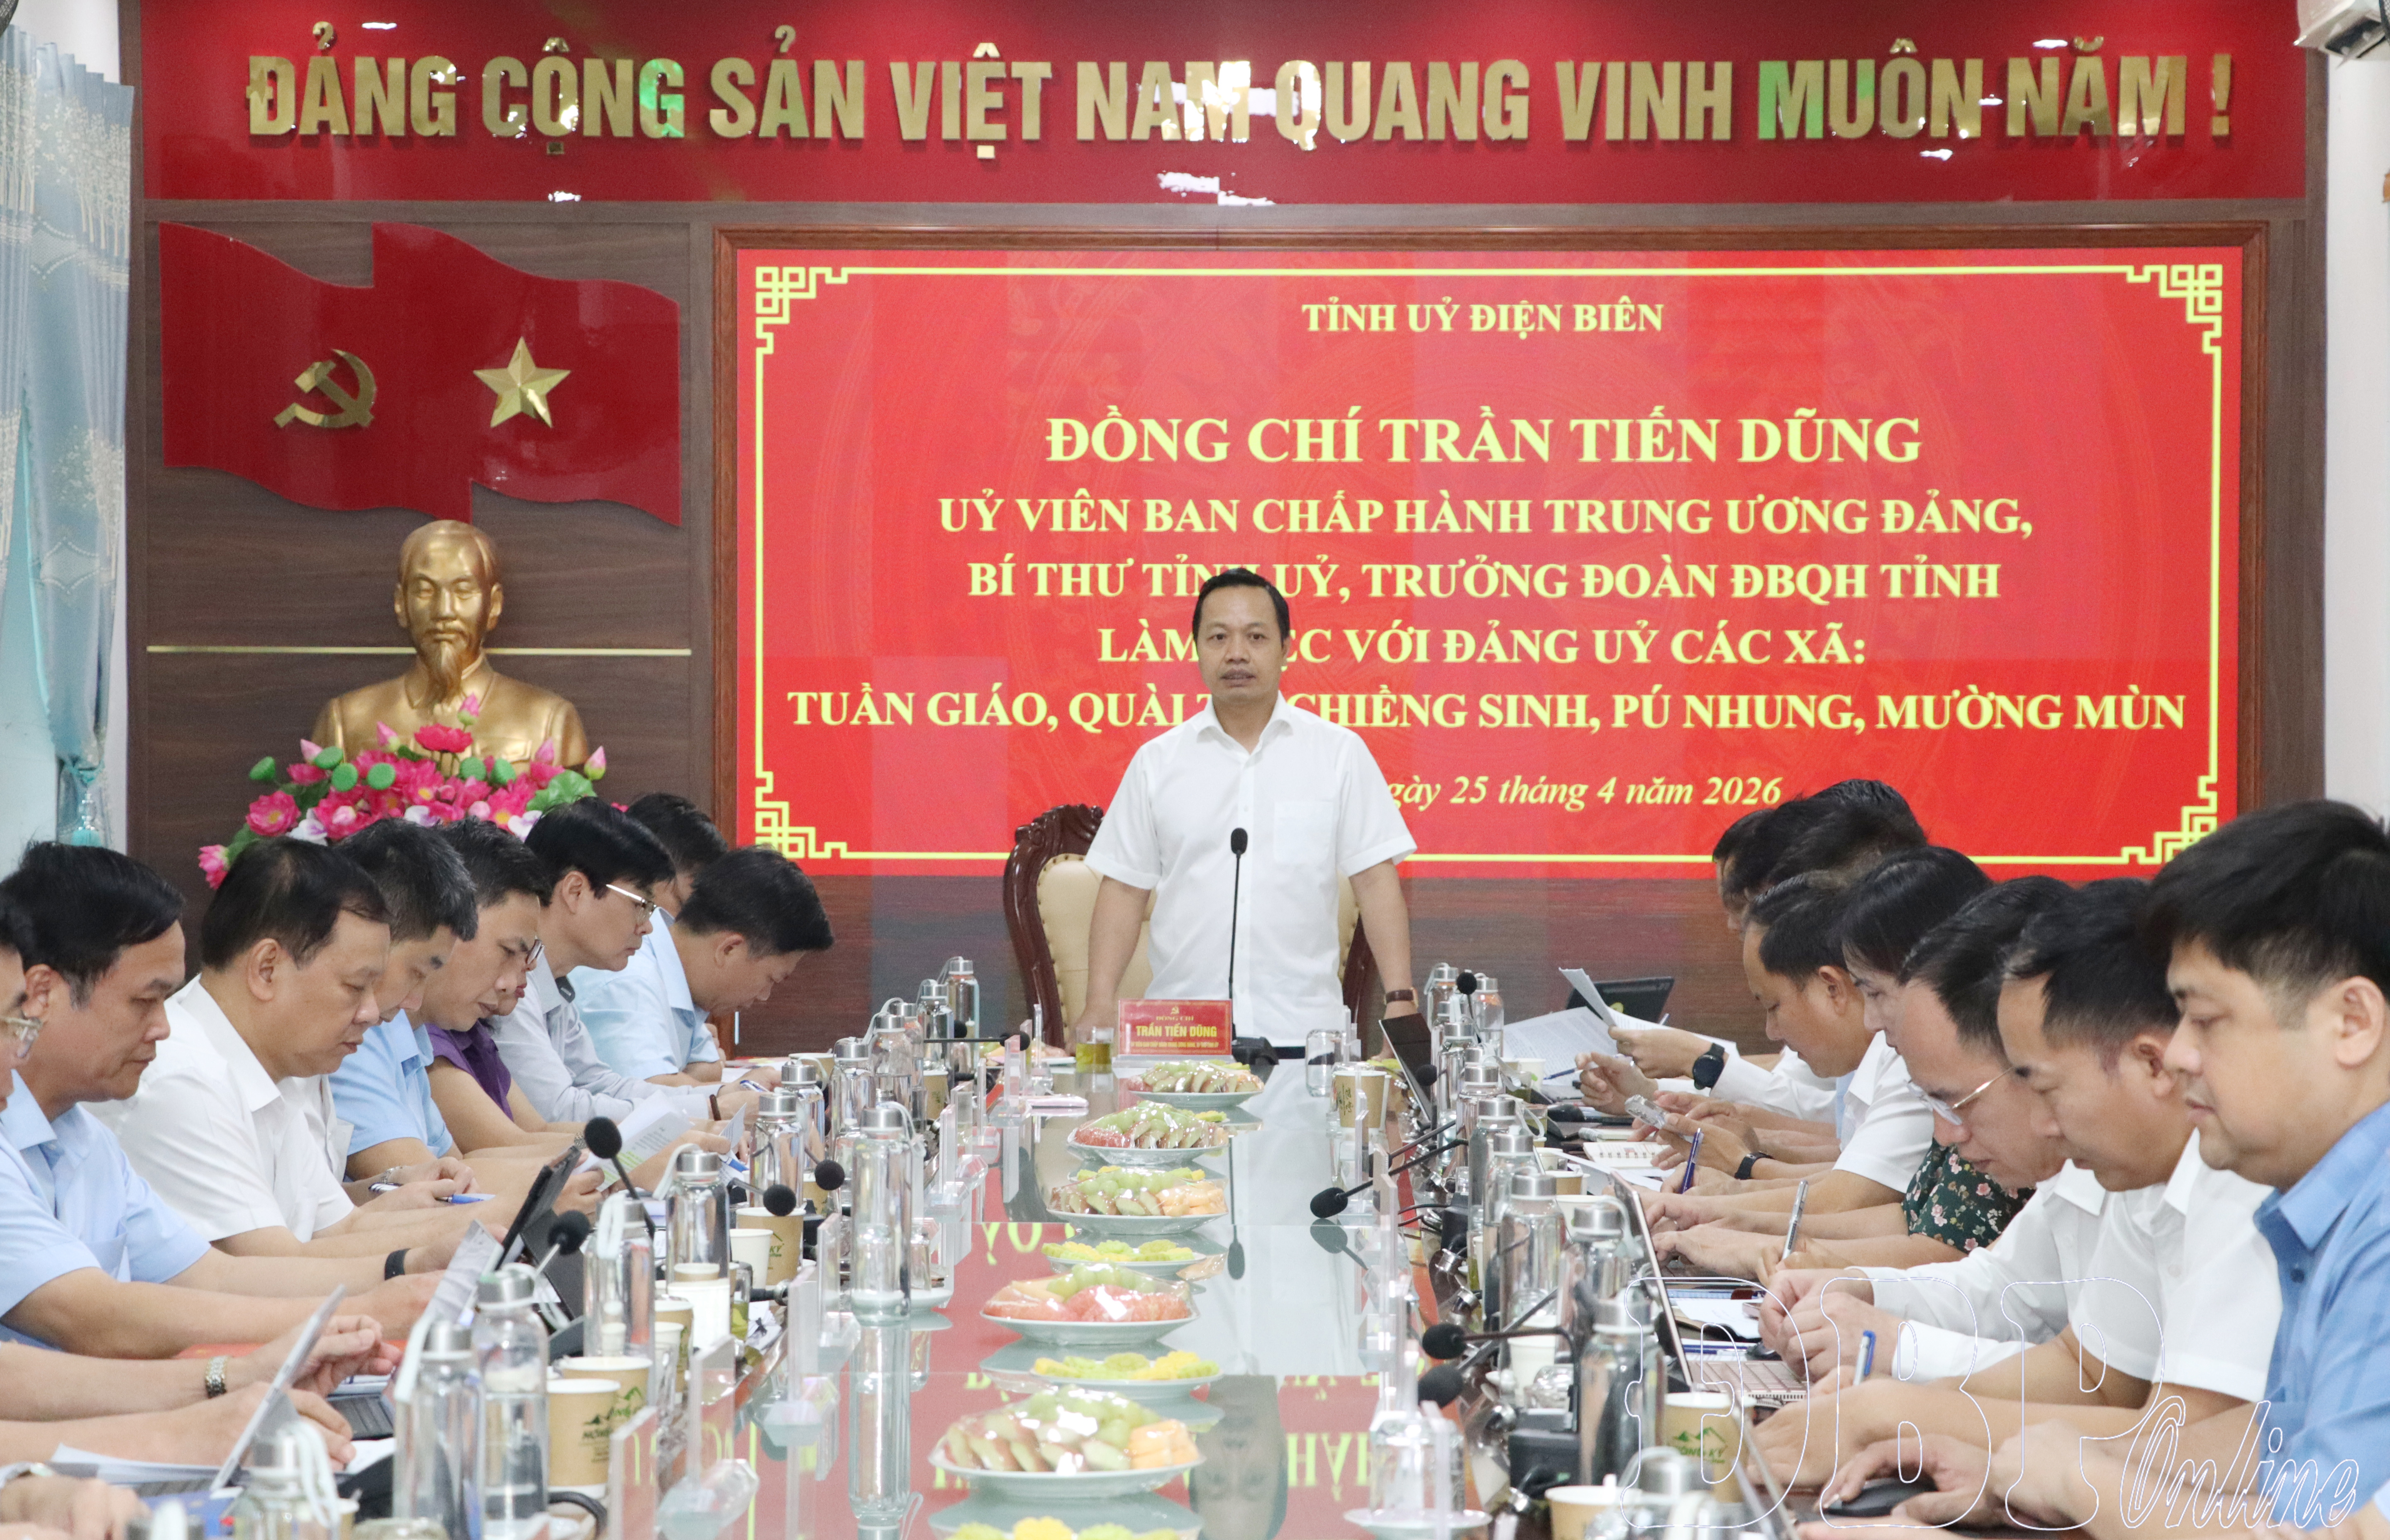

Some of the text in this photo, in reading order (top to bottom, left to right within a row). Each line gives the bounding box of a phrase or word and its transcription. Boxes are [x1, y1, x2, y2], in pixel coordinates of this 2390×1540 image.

[246, 21, 2231, 159] ĐẢNG CỘNG SẢN VIỆT NAM QUANG VINH MUÔN NĂM !
[1301, 295, 1664, 340] TỈNH UỶ ĐIỆN BIÊN
[1045, 405, 1922, 463] ĐỒNG CHÍ TRẦN TIẾN DŨNG
[938, 487, 2033, 538] UỶ VIÊN BAN CHẤP HÀNH TRUNG ƯƠNG ĐẢNG,
[967, 553, 2002, 605] BÍ THƯ TỈN UỶ, TRƯỞNG ĐOÀN ĐBQH TỈNH
[1097, 618, 1198, 662] LÀM
[1343, 619, 1431, 664] VỚI
[1442, 619, 1580, 664] ĐẢNG
[1592, 619, 1660, 664] UỶ
[1670, 619, 1771, 665] CÁC
[1784, 622, 1866, 664] XÃ:
[787, 682, 915, 726] TUẦN
[927, 682, 1058, 732] GIÁO,
[1069, 682, 1185, 733] QUÀI
[1478, 694, 1601, 734] SINH,
[1611, 684, 1671, 729] PÚ
[1683, 694, 1866, 734] NHUNG,
[1876, 684, 2063, 729] MƯỜNG
[2075, 684, 2185, 730] MÙN
[1387, 775, 1783, 812] gày 25 tháng 4 năm 2026
[1165, 1023, 1187, 1037] TIẾN
